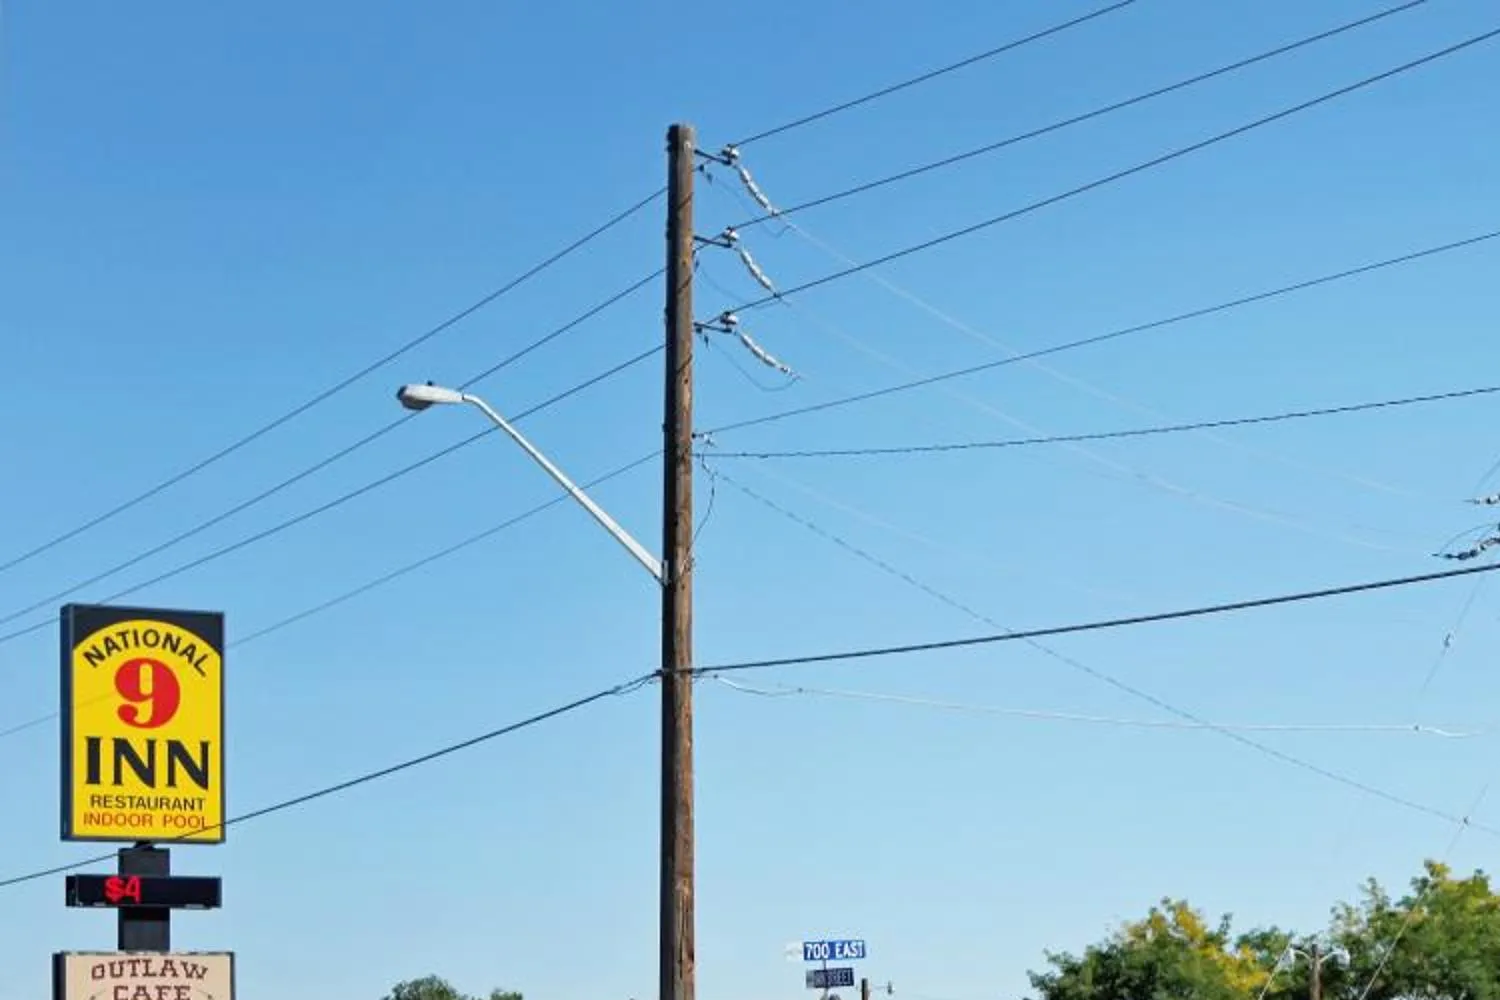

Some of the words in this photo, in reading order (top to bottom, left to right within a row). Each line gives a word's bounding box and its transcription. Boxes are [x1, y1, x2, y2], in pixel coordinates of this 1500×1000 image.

[83, 629, 209, 678] NATIONAL
[114, 657, 181, 729] 9
[85, 736, 210, 791] INN
[90, 794, 206, 812] RESTAURANT
[83, 813, 153, 827] INDOOR
[163, 815, 209, 830] POOL
[806, 943, 829, 959] 700
[835, 941, 864, 958] EAST
[91, 959, 209, 980] OUTLAW
